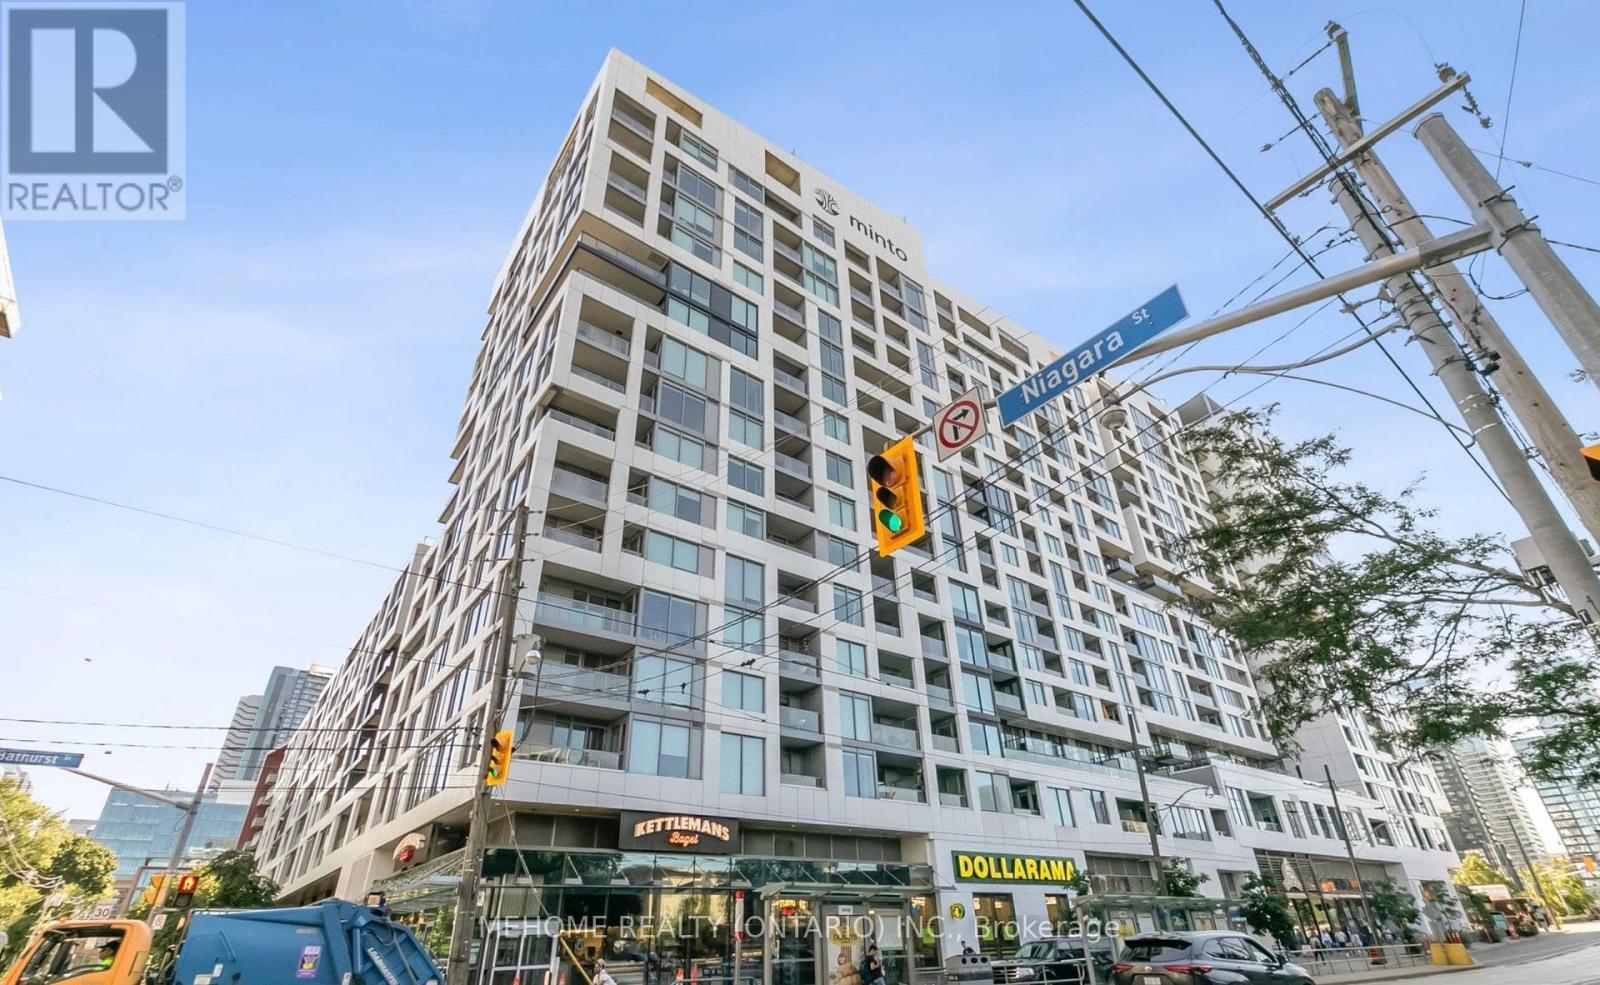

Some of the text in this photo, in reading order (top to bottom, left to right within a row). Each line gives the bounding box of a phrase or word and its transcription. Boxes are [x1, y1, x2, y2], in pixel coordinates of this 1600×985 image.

[849, 214, 907, 261] minto
[1021, 307, 1150, 404] Niagara St
[634, 816, 729, 841] KETTLEMANS
[669, 831, 699, 847] Bagel
[95, 907, 110, 917] 30
